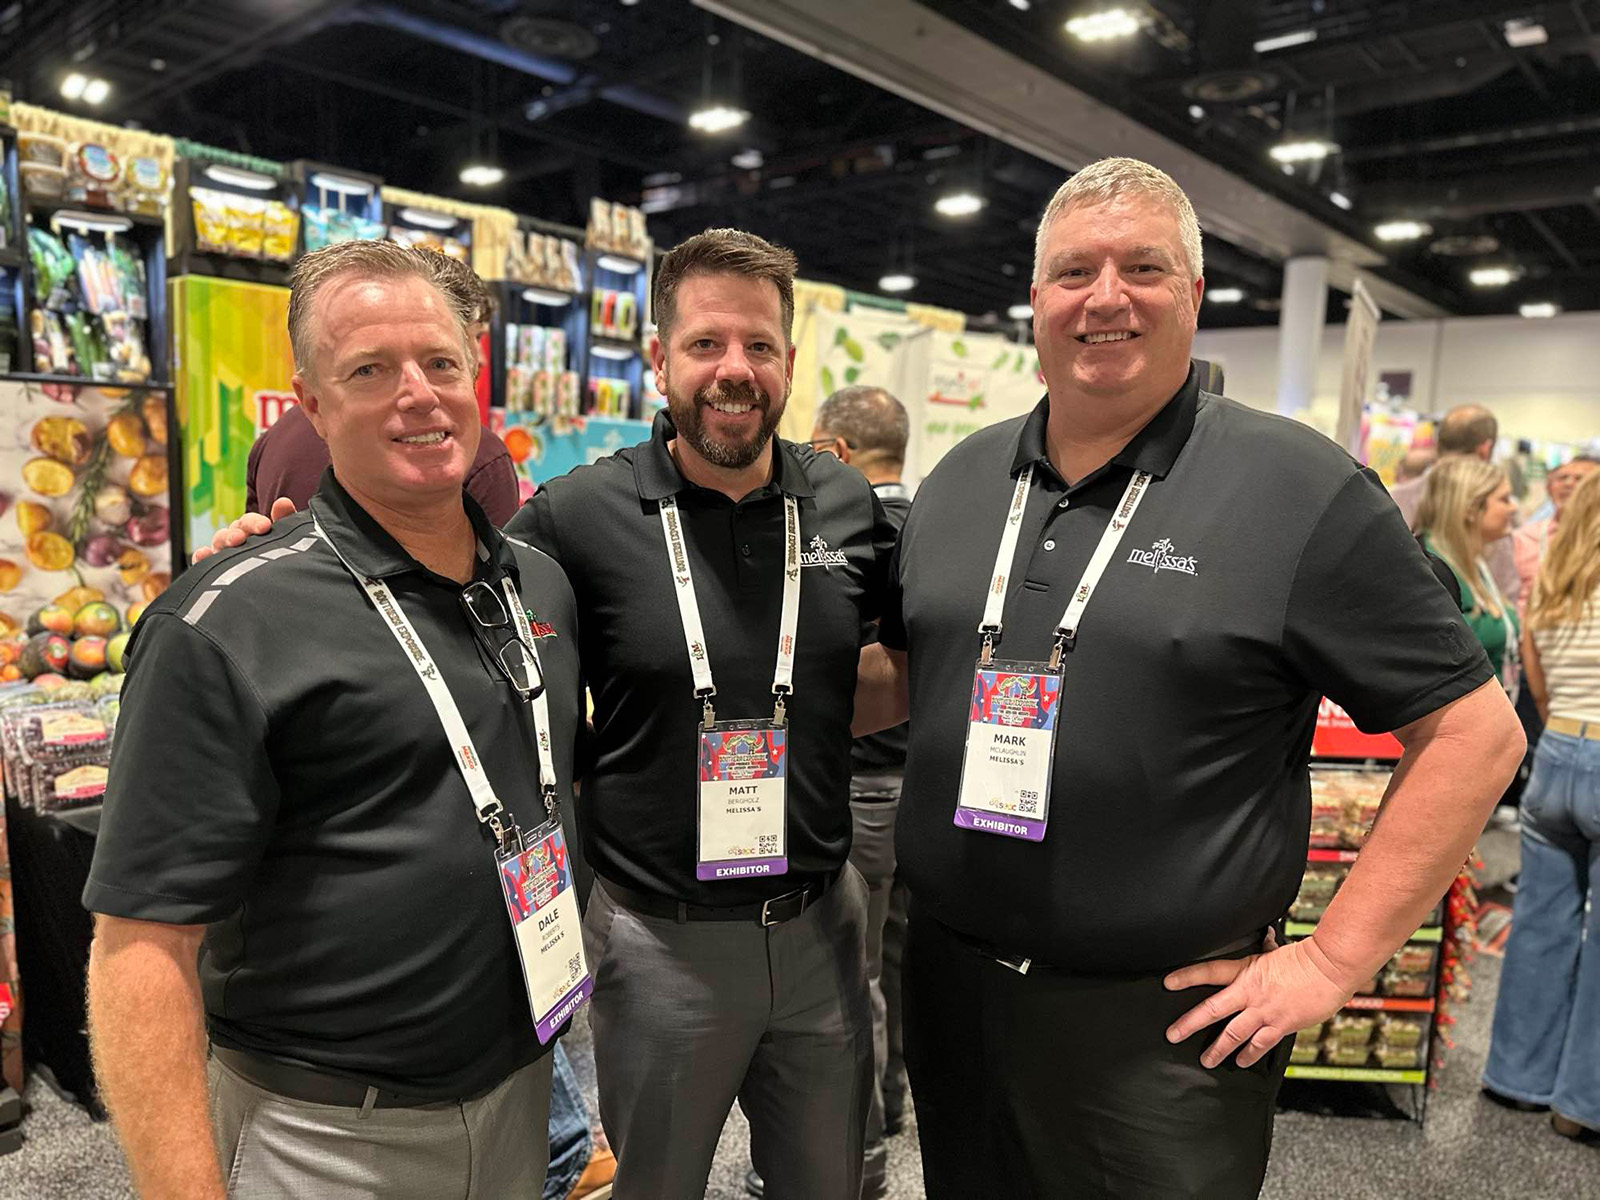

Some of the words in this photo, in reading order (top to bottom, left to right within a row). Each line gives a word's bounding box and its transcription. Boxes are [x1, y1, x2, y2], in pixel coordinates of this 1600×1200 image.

[373, 589, 401, 627] SOUTHERN
[994, 733, 1027, 747] MARK
[990, 746, 1026, 757] MCLAUGHLIN
[989, 755, 1025, 766] MELISSA'S
[729, 785, 758, 795] MATT
[727, 797, 760, 805] BERGHOLZ
[973, 817, 1028, 835] EXHIBITOR
[716, 863, 770, 877] EXHIBITOR
[538, 908, 560, 931] DALE
[549, 990, 584, 1029] EXHIBITOR
